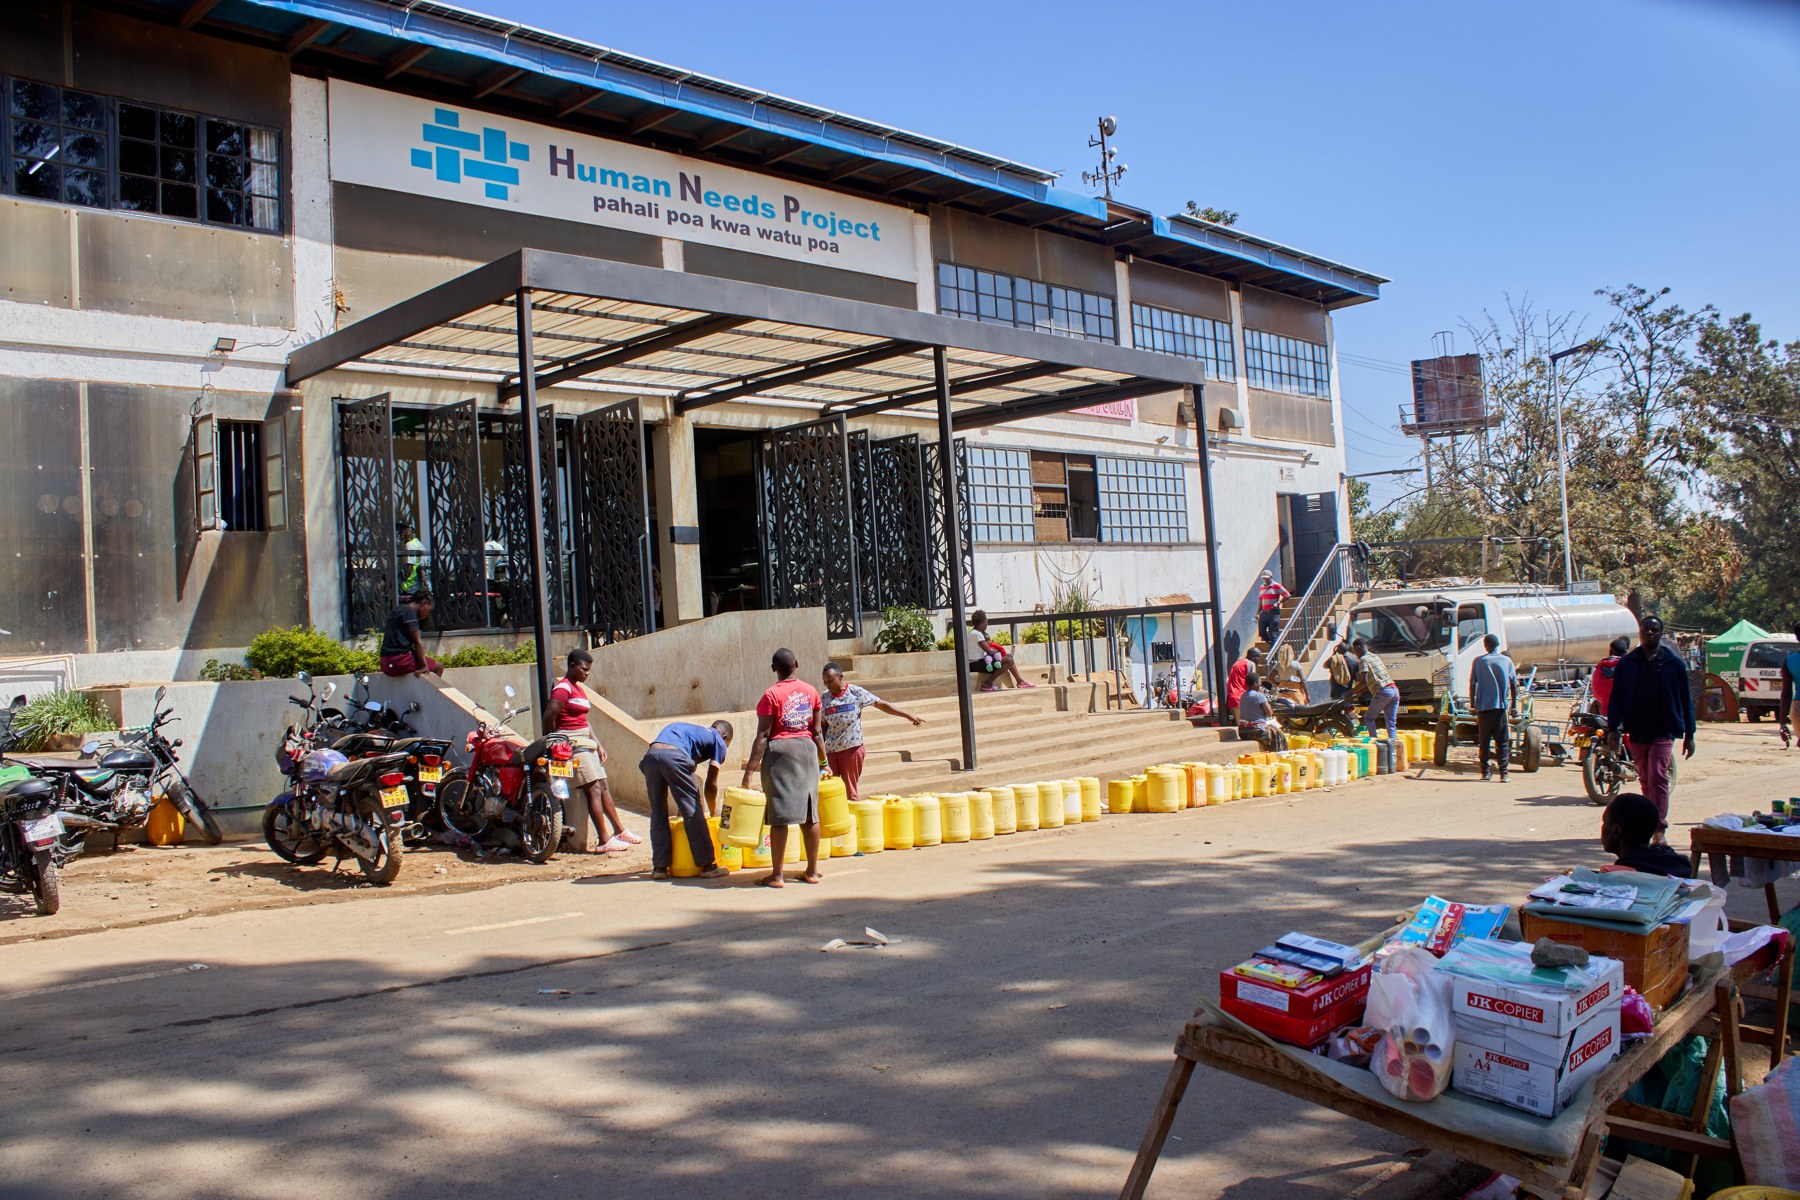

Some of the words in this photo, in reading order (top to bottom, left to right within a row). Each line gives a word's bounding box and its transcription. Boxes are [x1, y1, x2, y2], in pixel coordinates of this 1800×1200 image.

[549, 145, 671, 198] Human
[679, 172, 776, 219] Needs
[783, 194, 881, 242] Project
[593, 195, 659, 219] pahali
[666, 209, 704, 227] poa
[710, 214, 751, 236] kwa
[756, 226, 802, 247] watu
[808, 237, 839, 254] poa
[1318, 991, 1333, 1009] JK
[1333, 977, 1359, 1001] COPIER
[1470, 995, 1492, 1009] JK
[1494, 1001, 1539, 1021] COPIER
[1577, 998, 1588, 1014] JK
[1588, 986, 1608, 1006] COPIER
[1474, 1058, 1491, 1072] A4
[1487, 1053, 1499, 1062] JK
[1501, 1057, 1527, 1070] COPIER
[1571, 1048, 1584, 1069] JK
[1584, 1031, 1610, 1059] COPIER
